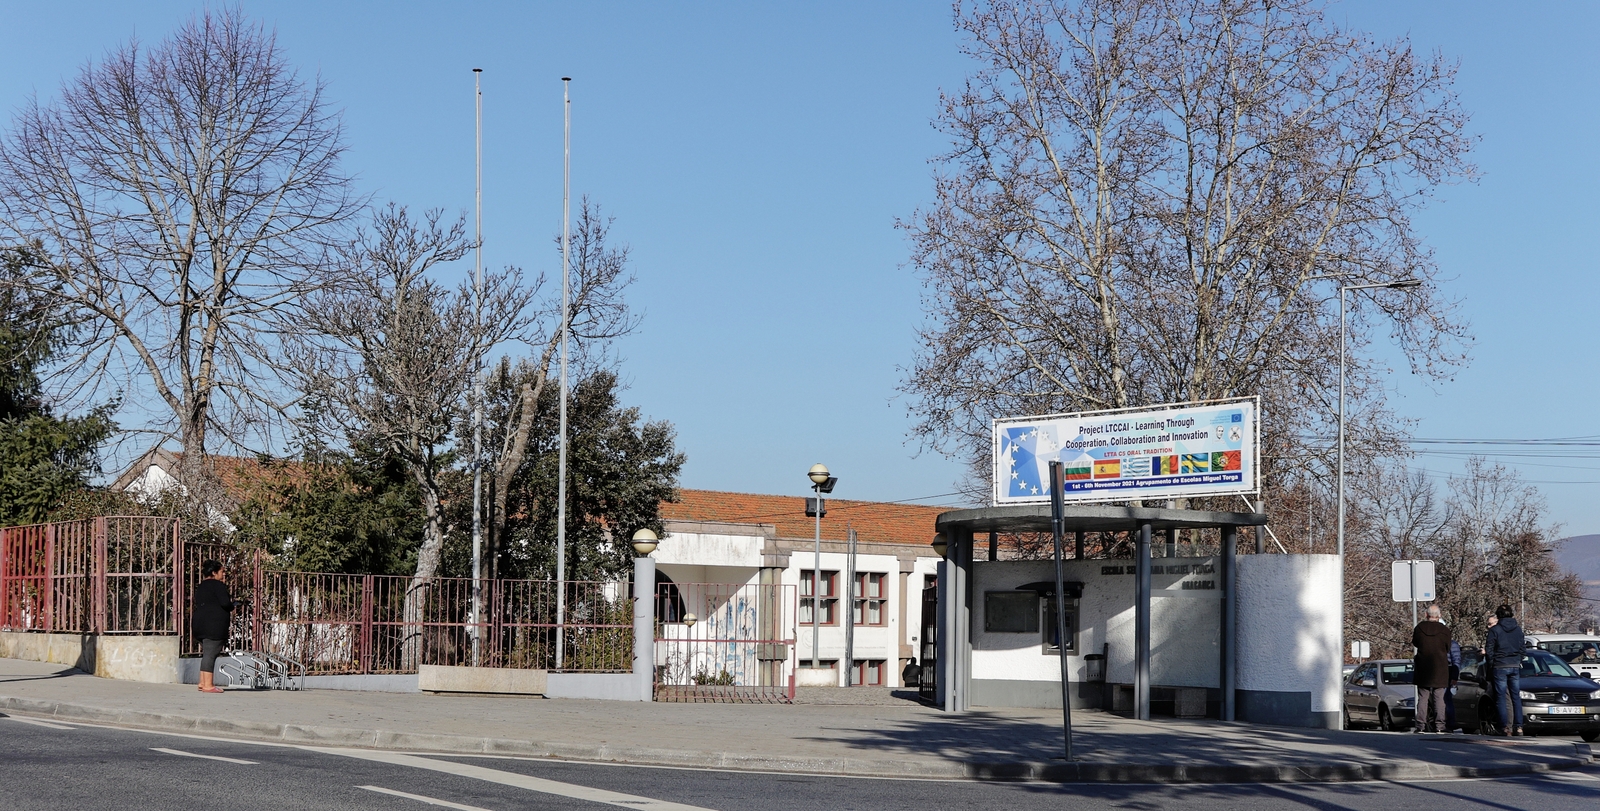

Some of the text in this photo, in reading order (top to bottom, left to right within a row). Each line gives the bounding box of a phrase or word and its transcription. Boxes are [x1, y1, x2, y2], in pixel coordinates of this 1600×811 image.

[1079, 426, 1103, 435] Project
[1105, 423, 1129, 433] LTCCAI
[1136, 420, 1164, 430] Learning
[1166, 417, 1194, 428] Through
[1066, 430, 1208, 450] Cooperation, Collaboration and Innovation
[1136, 478, 1171, 487] Agrupamento
[1102, 566, 1124, 575] ESCOLA
[1166, 565, 1188, 574] MIGUEL
